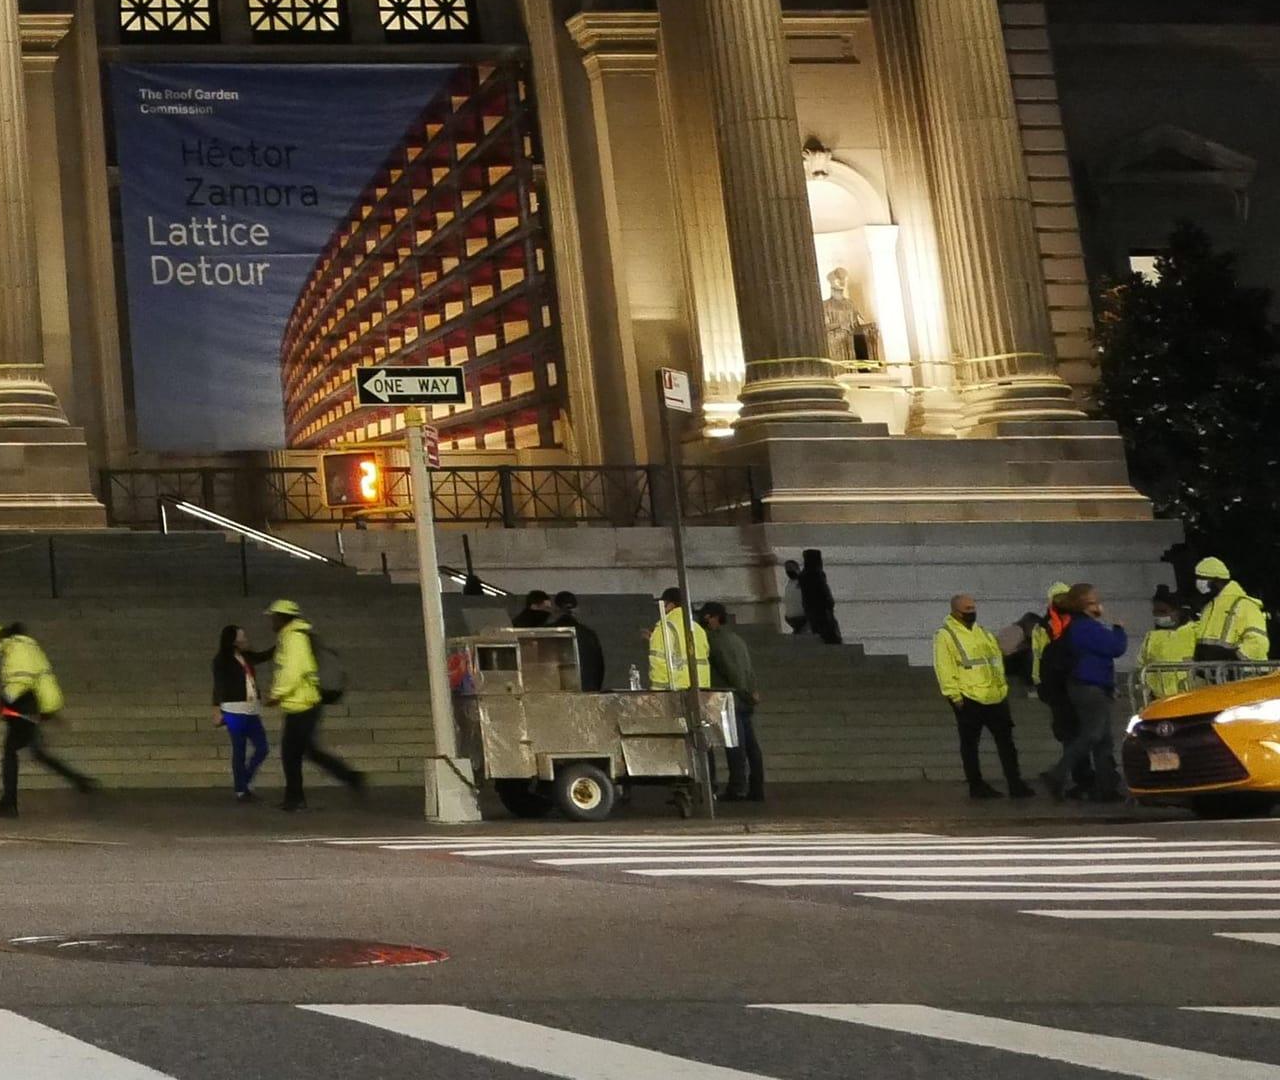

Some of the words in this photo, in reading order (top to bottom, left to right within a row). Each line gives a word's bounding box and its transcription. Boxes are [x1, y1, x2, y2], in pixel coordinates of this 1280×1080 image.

[139, 88, 162, 100] The
[164, 88, 193, 100] Roof
[194, 88, 239, 100] Garden
[140, 103, 213, 114] Commission
[185, 177, 319, 207] Zamora
[148, 214, 270, 246] Lattice
[150, 255, 270, 286] Detour
[374, 378, 404, 393] ONE
[418, 378, 450, 393] WAY
